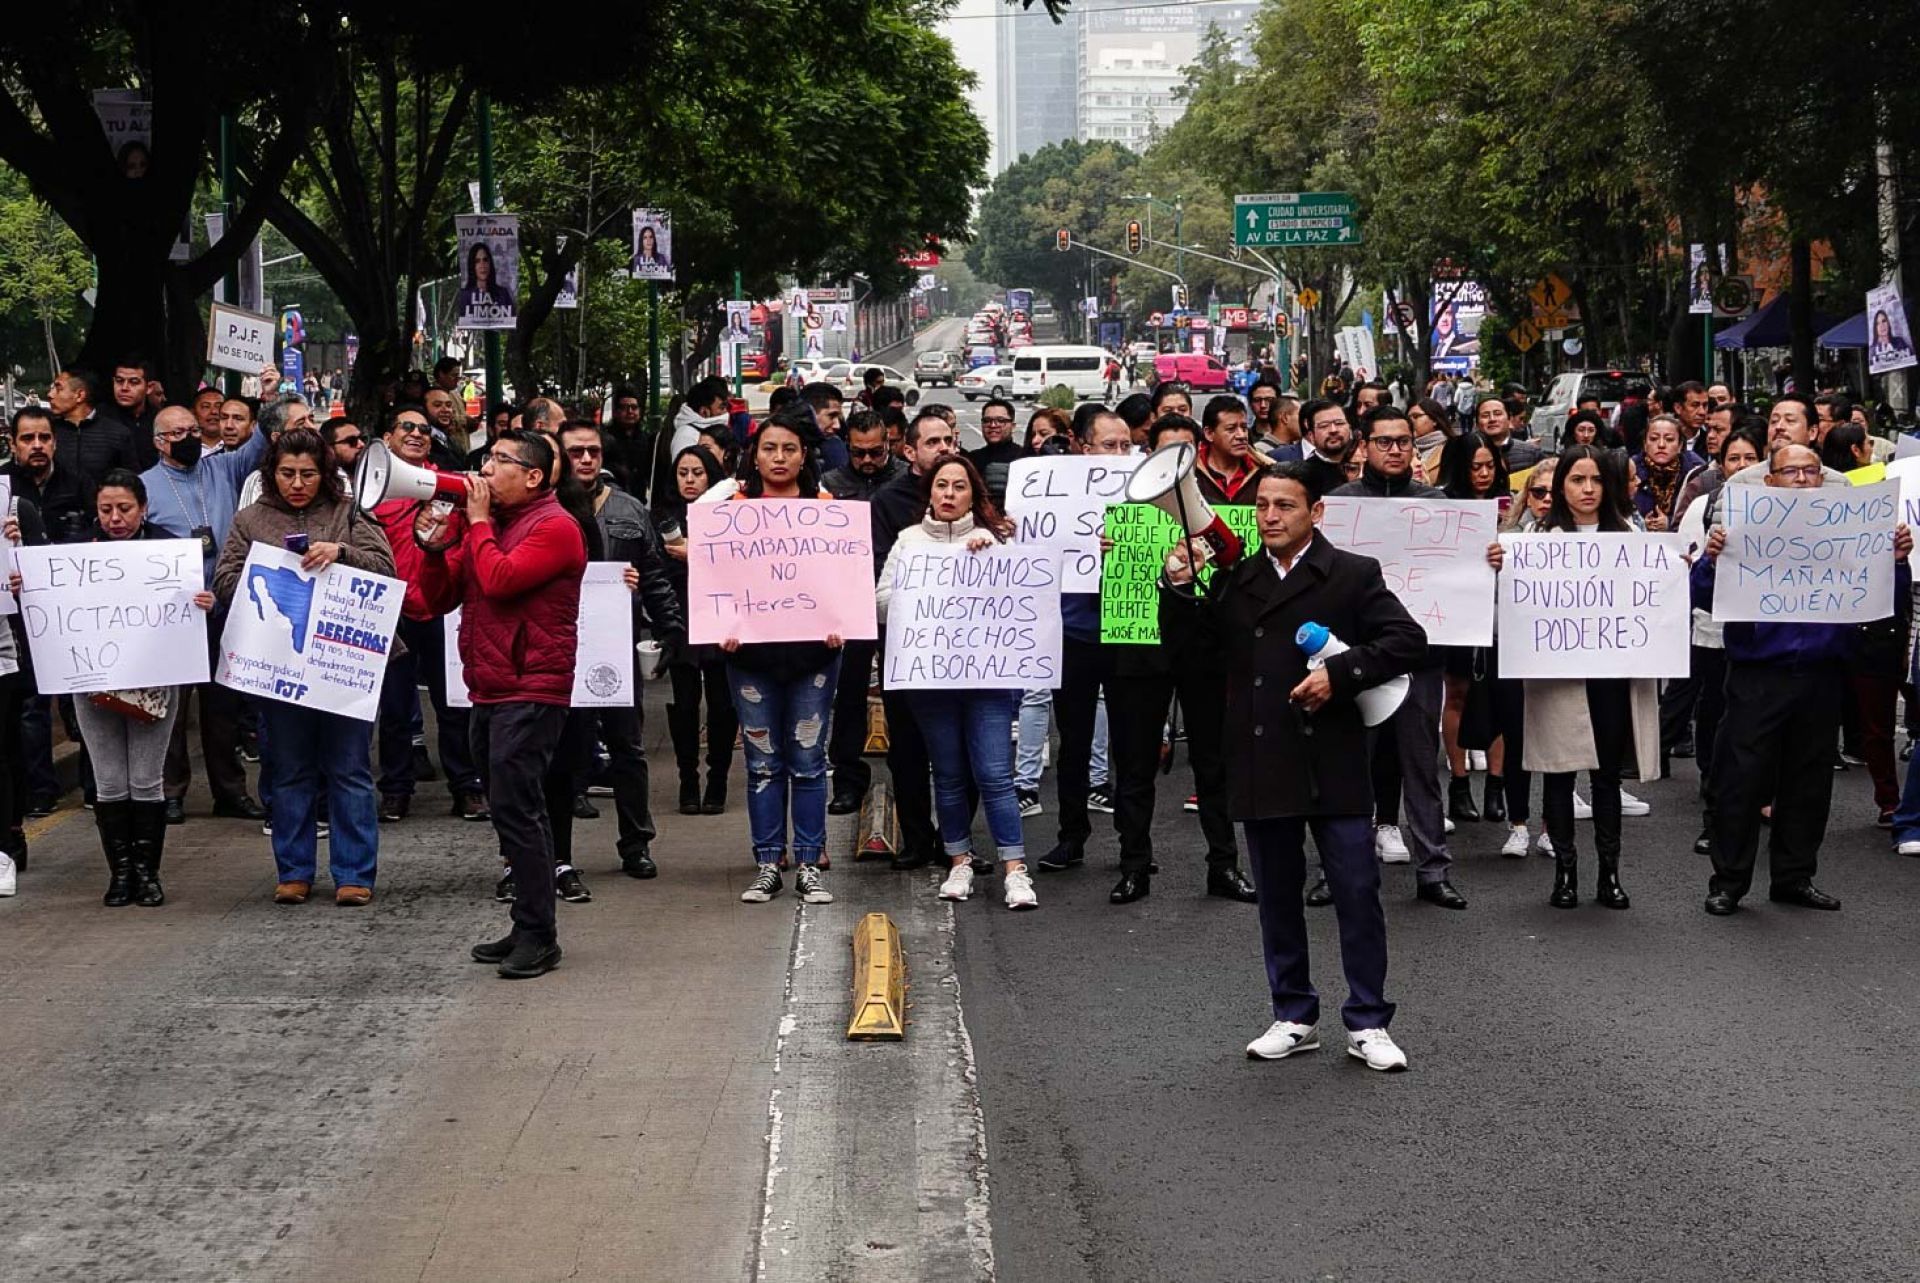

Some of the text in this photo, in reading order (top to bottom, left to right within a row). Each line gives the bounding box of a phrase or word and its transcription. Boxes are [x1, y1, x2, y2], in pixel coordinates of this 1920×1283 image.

[1268, 204, 1350, 217] CIUDAD UNIVERSITARIA
[460, 227, 514, 237] TU ALIADA
[1246, 230, 1329, 243] AV DE LA PAZ
[464, 302, 513, 318] LIMÓN
[228, 324, 262, 345] P.J.F.
[218, 344, 264, 363] NO SE TOCA
[1021, 467, 1134, 498] EL PJ
[704, 503, 850, 537] SOMOS
[1229, 508, 1257, 526] QUE
[1724, 486, 1894, 528] HOY SOMOS
[1021, 511, 1056, 543] NO
[1112, 526, 1159, 544] QUEJE
[1321, 503, 1481, 547] EL PJF
[697, 536, 870, 564] TRABAJADORES
[1109, 545, 1155, 563] TENGA
[1512, 541, 1669, 570] RESPETO A LA
[1744, 531, 1895, 561] NOSOTROS
[14, 551, 125, 593] LEYES
[770, 562, 797, 581] NO
[895, 553, 1054, 590] DEFENDAMOS
[1106, 564, 1124, 580] LO
[1381, 562, 1430, 593] SE
[1738, 563, 1868, 588] MAÑANA
[324, 588, 356, 613] trabaja
[351, 577, 388, 604] PJF
[1104, 582, 1121, 599] LO
[1514, 575, 1662, 608] DIVISIÓN DE
[1760, 588, 1868, 615] QUIÉN?
[25, 602, 192, 638] DICTADURA
[320, 606, 376, 631] defender tus
[915, 594, 1038, 622] NUESTROS
[1103, 600, 1150, 619] FUERTE
[316, 619, 389, 651] DERECHOS
[902, 625, 1036, 651] DERECHOS
[1535, 615, 1649, 652] PODERES
[69, 641, 119, 673] NO
[328, 644, 343, 656] nos
[346, 647, 365, 661] toca
[357, 668, 375, 680] para
[890, 654, 1054, 683] LABORALES
